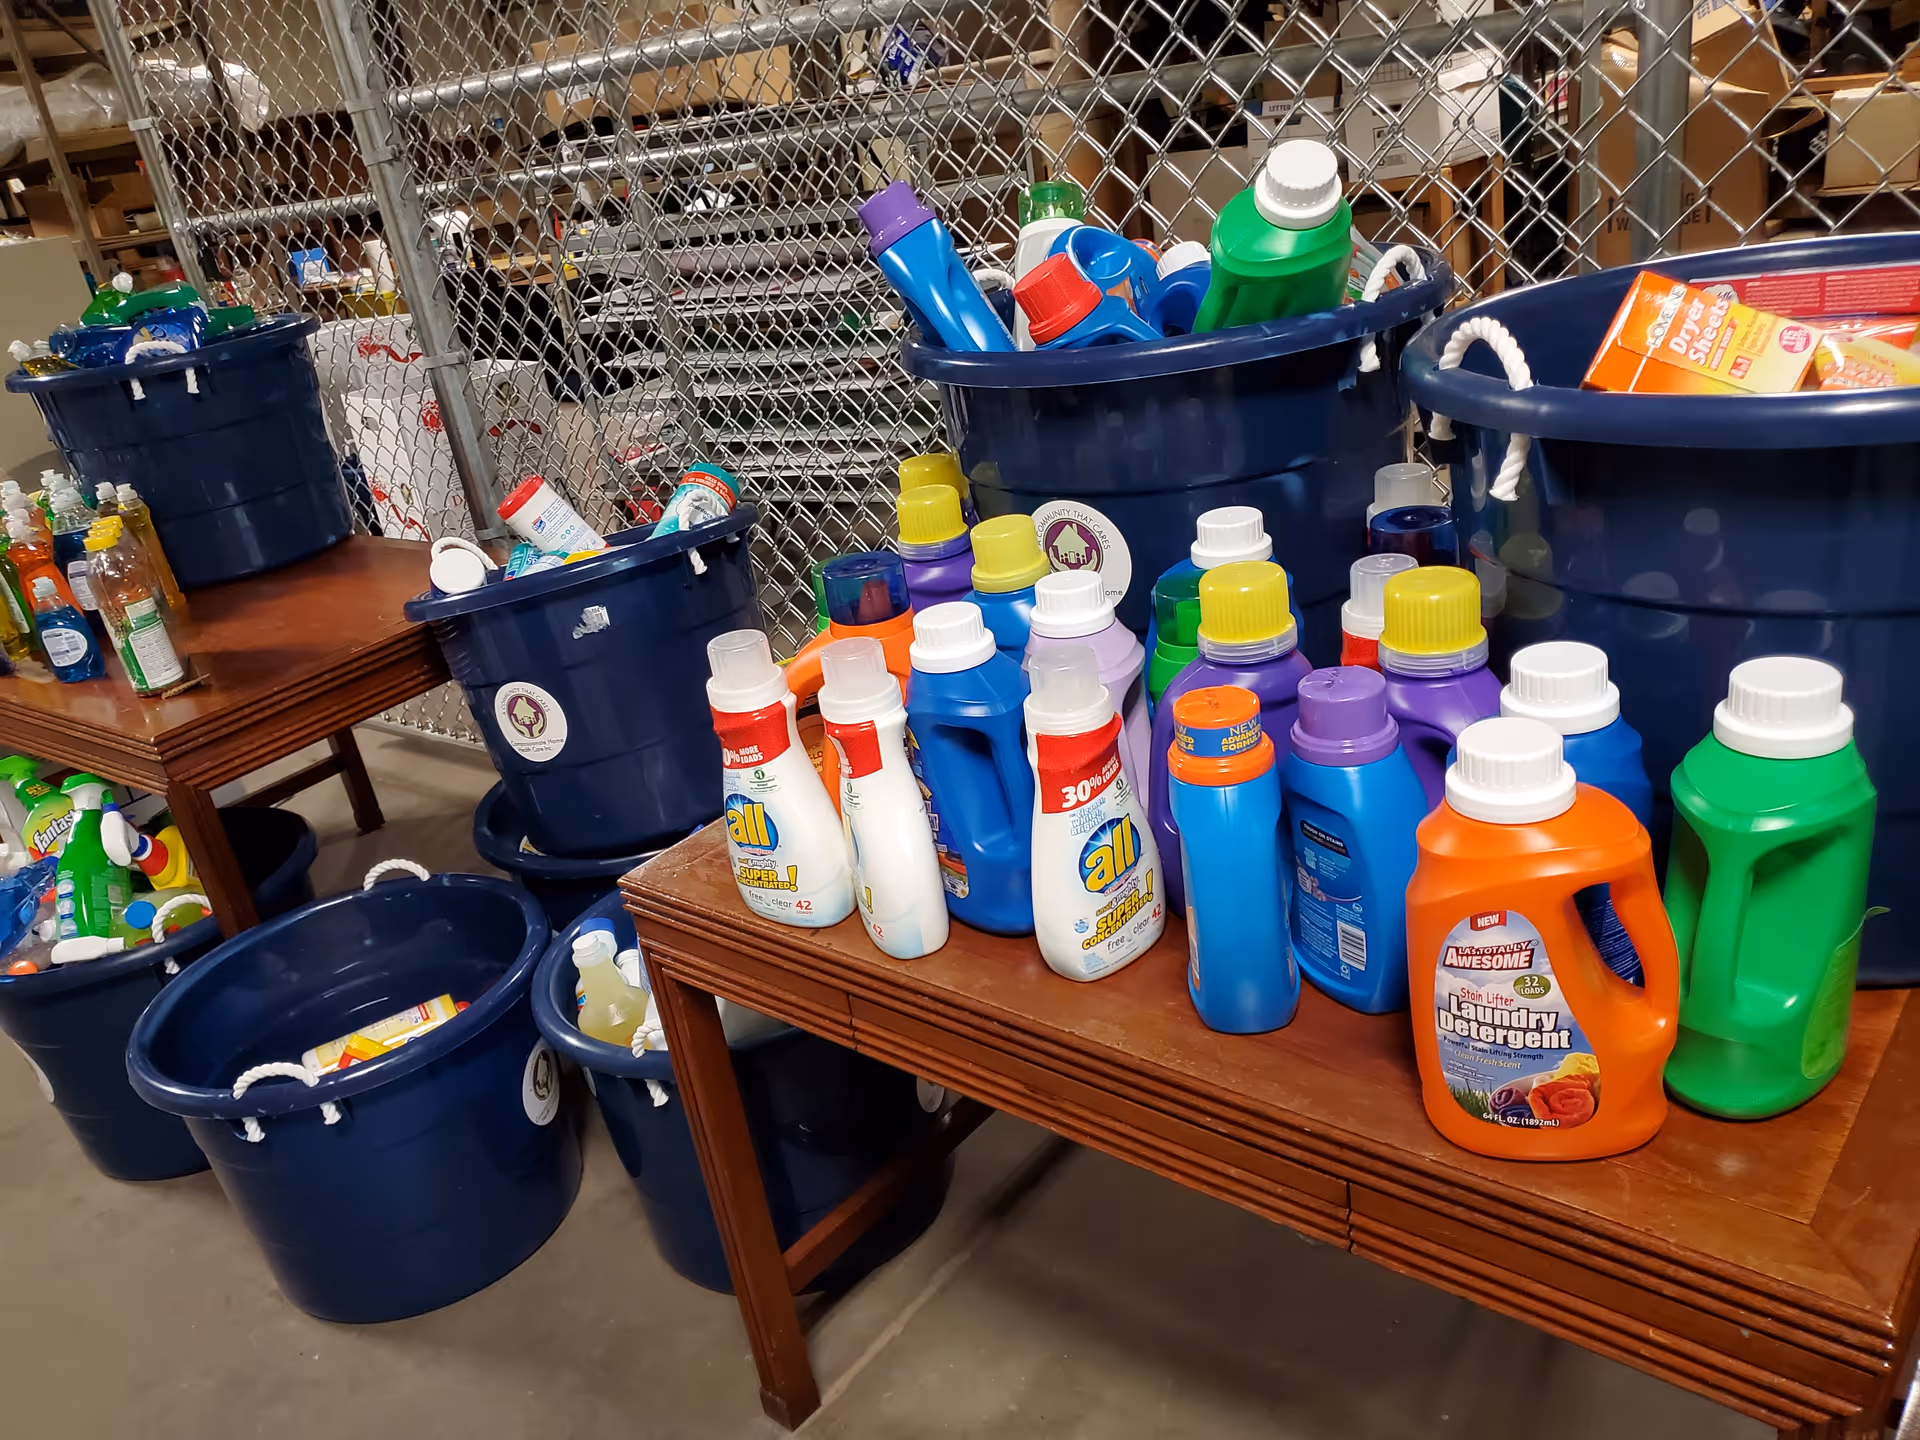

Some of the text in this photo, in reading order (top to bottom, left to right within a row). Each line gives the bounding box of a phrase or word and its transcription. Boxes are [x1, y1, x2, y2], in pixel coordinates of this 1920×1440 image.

[1669, 296, 1706, 356] Dryer
[1688, 298, 1730, 366] Sheets
[1036, 508, 1071, 538] COMMUNITY
[1073, 510, 1093, 525] THAT
[1093, 524, 1111, 550] CARES
[522, 688, 535, 697] THAT
[536, 695, 551, 712] CARES
[1230, 717, 1257, 736] NEW
[722, 748, 740, 766] 0%
[739, 745, 759, 755] MORE
[740, 752, 764, 764] LOADS
[1102, 760, 1119, 783] LOADS
[1062, 774, 1102, 808] 30%
[33, 809, 75, 855] fantas
[727, 804, 771, 846] all
[1326, 836, 1343, 847] STAINS
[1085, 815, 1135, 892] all
[740, 867, 777, 881] SUPER
[749, 890, 792, 908] free clear
[796, 900, 812, 910] 42
[1097, 889, 1139, 933] SUPER
[1152, 903, 1161, 919] 42
[1477, 914, 1500, 927] NEW
[873, 924, 884, 937] 42
[1107, 916, 1150, 951] free clear
[1480, 941, 1529, 954] TOTALLY
[1444, 948, 1531, 969] AWESOME
[1524, 976, 1539, 986] 32
[1460, 988, 1514, 1008] Stain Lifter
[1450, 995, 1557, 1031] Laundry
[1440, 1009, 1570, 1049] Detergent
[1443, 1036, 1544, 1060] Powerful Stain Lifting Strength
[1455, 1049, 1521, 1069] Clean Fresh Scent
[1521, 1118, 1559, 1127] (1892mL)
